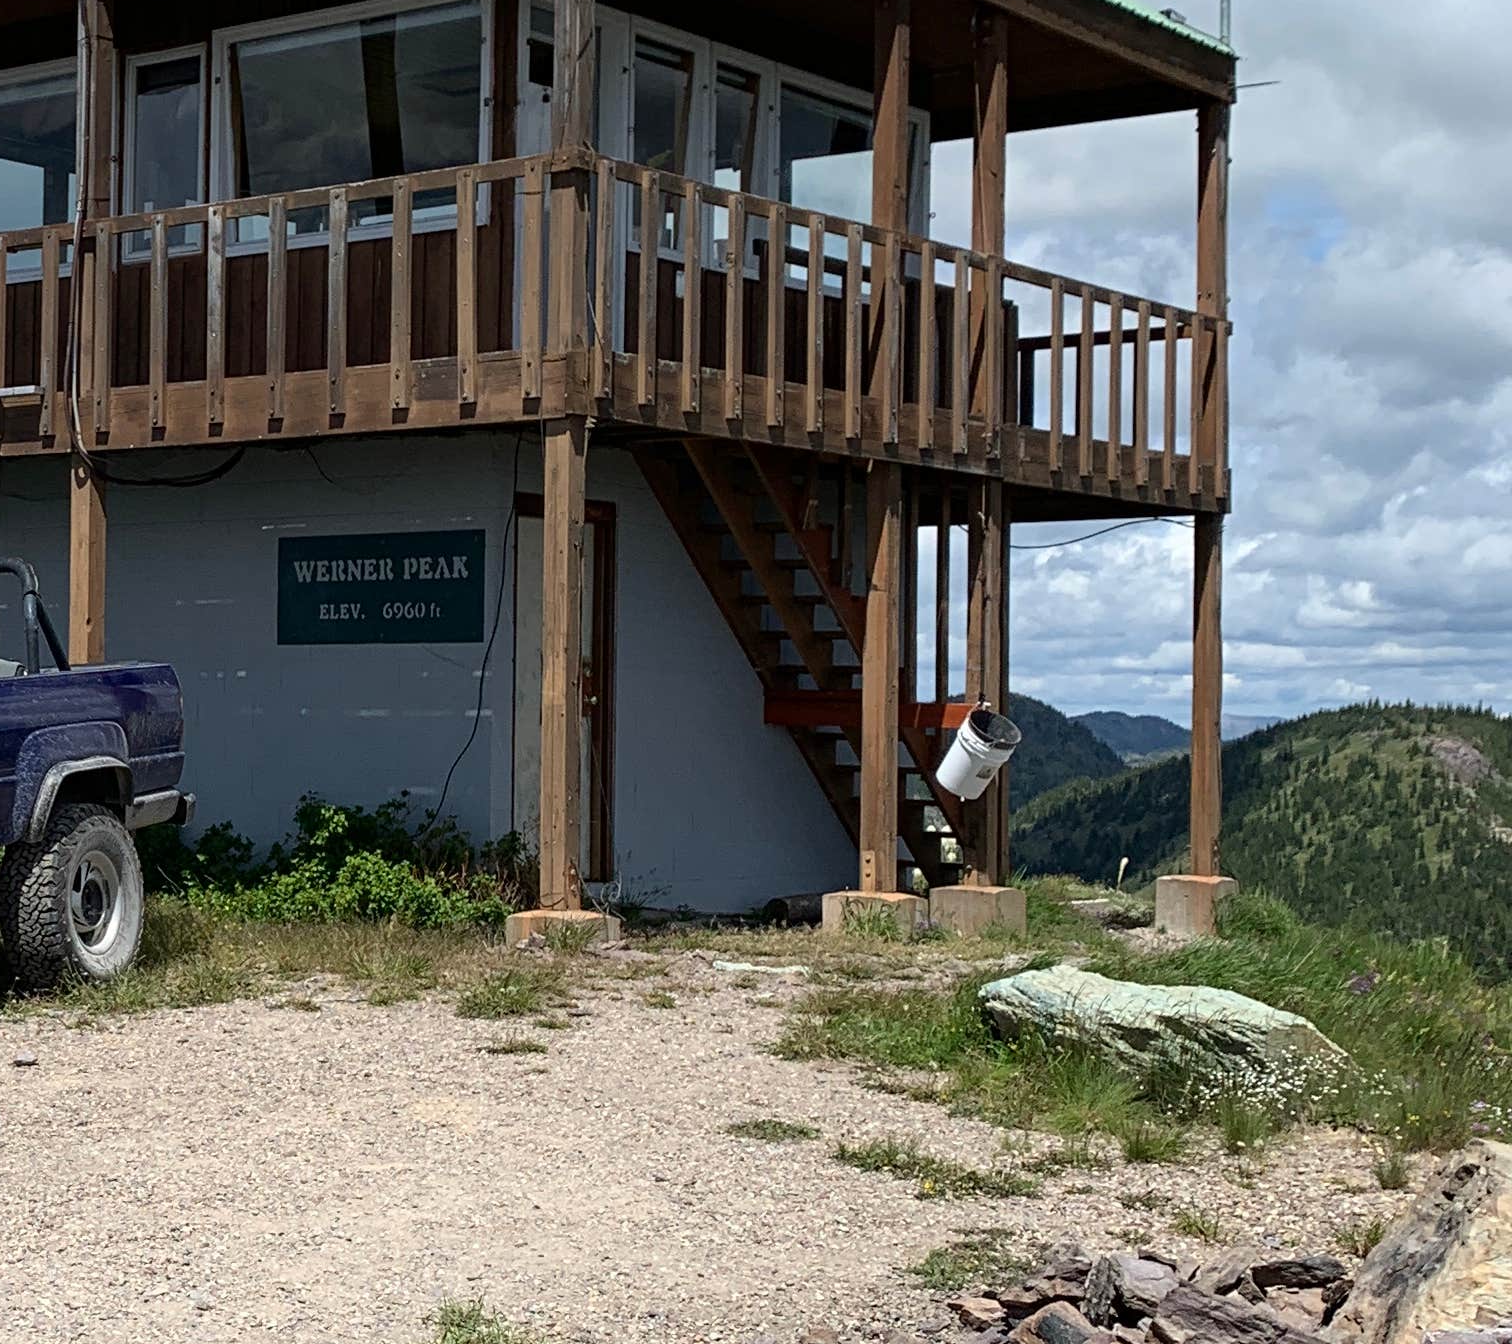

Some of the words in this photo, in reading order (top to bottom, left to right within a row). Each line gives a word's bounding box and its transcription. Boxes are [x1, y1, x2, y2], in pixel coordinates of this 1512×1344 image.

[293, 558, 394, 583] WERNER
[403, 556, 469, 580] PEAK
[319, 603, 366, 620] ELEV.
[382, 602, 426, 619] 6960
